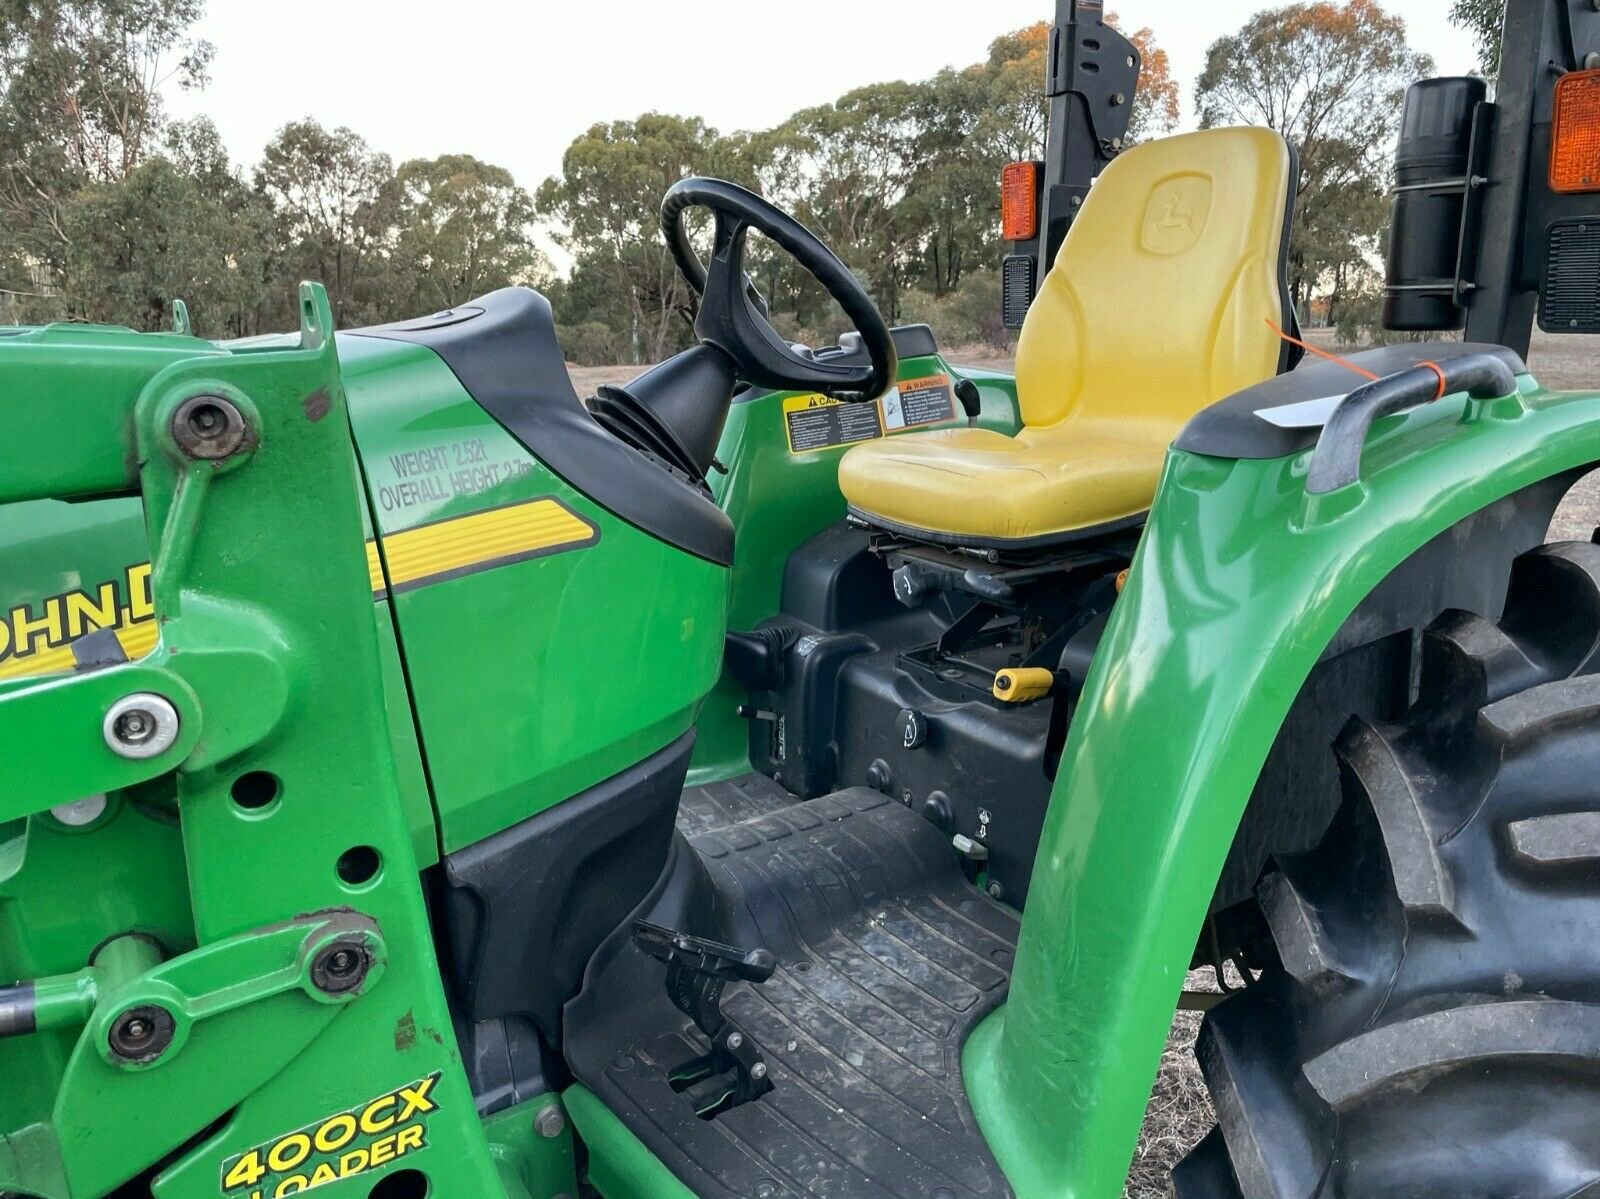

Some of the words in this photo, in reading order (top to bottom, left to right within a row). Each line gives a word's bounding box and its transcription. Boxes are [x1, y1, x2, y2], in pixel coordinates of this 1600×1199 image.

[819, 397, 838, 405] CAU
[914, 378, 943, 390] WARNING
[389, 446, 450, 479] WEIGHT
[452, 439, 489, 466] 2.52t
[378, 477, 450, 512] OVERALL
[451, 464, 501, 496] HEIGHT
[0, 581, 119, 659] HN
[224, 1074, 438, 1190] 400CX
